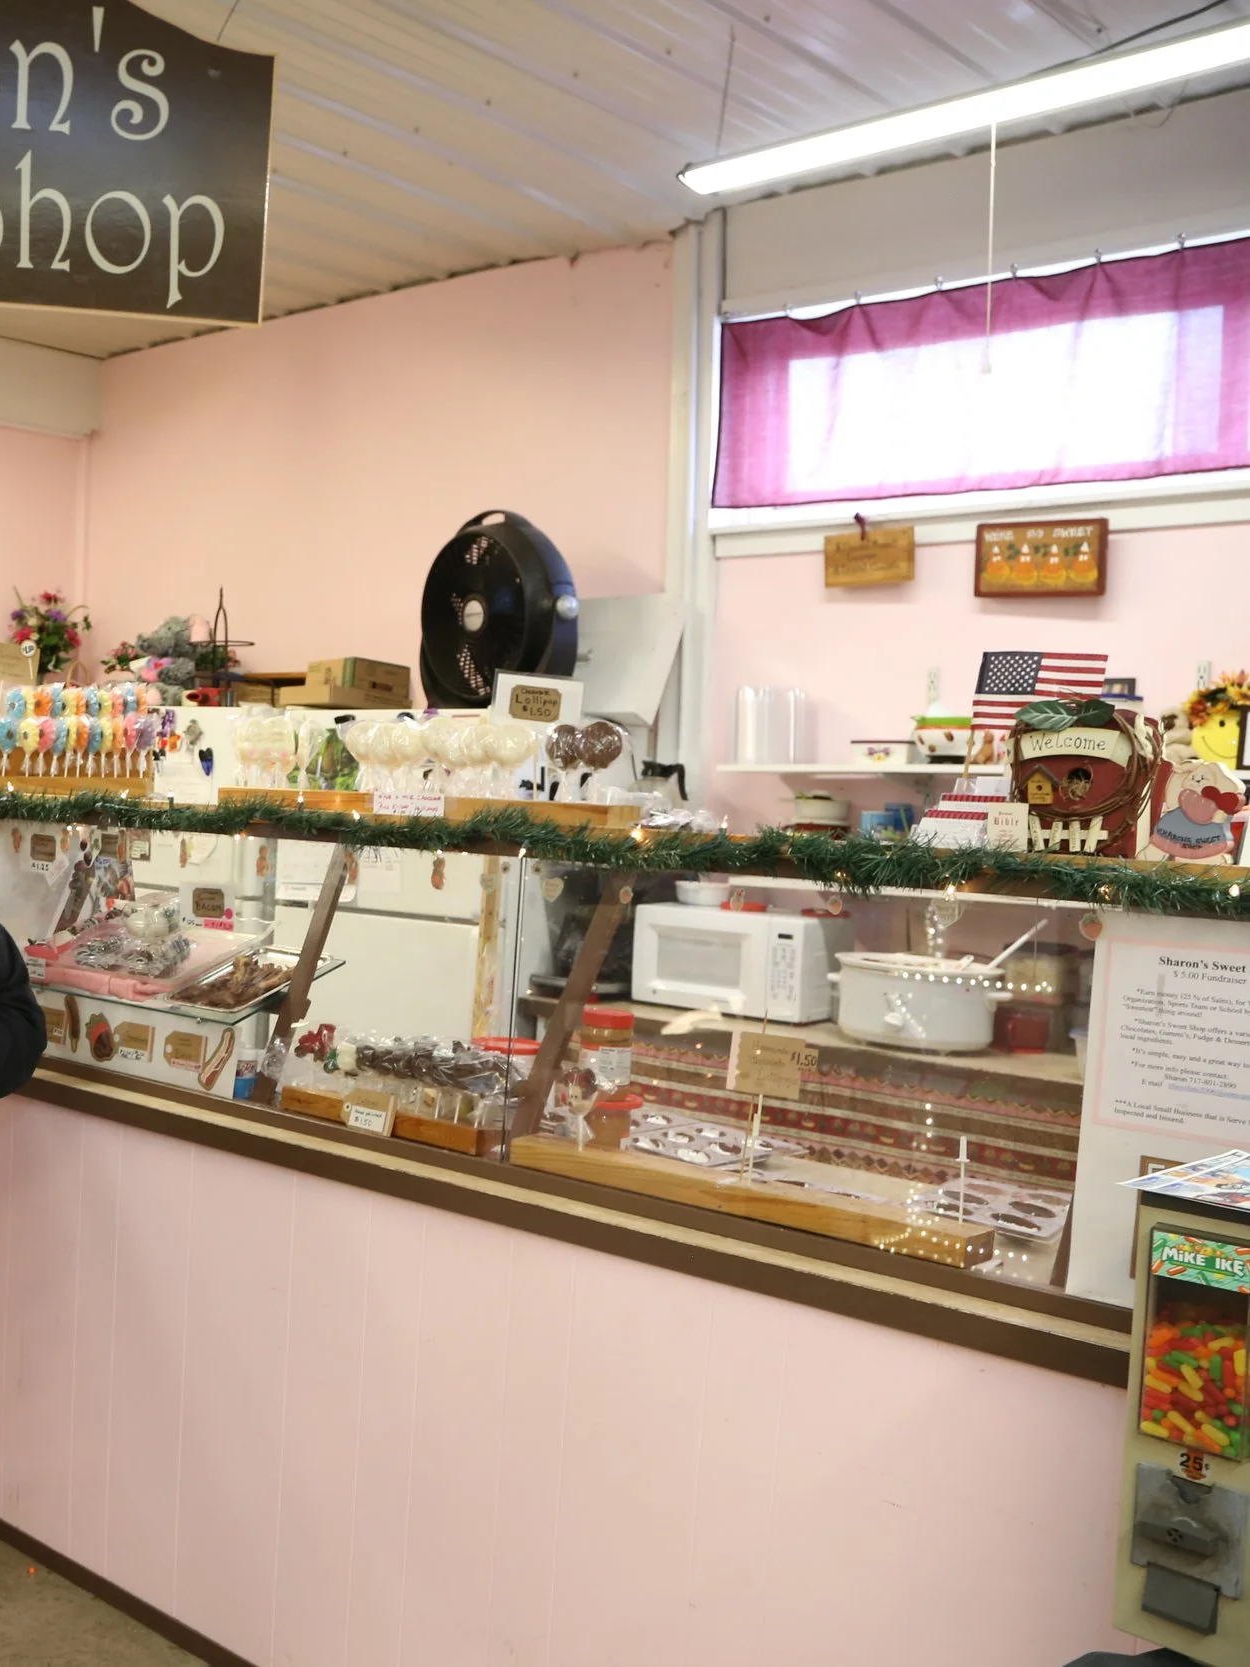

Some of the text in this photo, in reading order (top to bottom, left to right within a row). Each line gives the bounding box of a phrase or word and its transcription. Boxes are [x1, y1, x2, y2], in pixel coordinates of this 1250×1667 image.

[1030, 733, 1106, 751] Welcome
[994, 816, 1019, 826] Bible
[1158, 955, 1246, 973] Sharon's Sweet
[1180, 971, 1200, 980] 5.00
[1201, 972, 1248, 985] Fundraiser
[1168, 999, 1188, 1009] Sports
[1190, 1002, 1208, 1010] Team
[1218, 1006, 1242, 1014] School
[1236, 998, 1246, 1006] for
[1158, 1006, 1176, 1016] thing
[1168, 1021, 1187, 1030] Sweet
[1189, 1024, 1207, 1034] Shop
[1207, 1026, 1228, 1035] offers
[1192, 1033, 1214, 1043] Fudge
[790, 1051, 817, 1067] $1.50
[1148, 1050, 1170, 1059] simple,
[1208, 1058, 1226, 1066] great
[1227, 1060, 1241, 1068] way
[1164, 1073, 1188, 1083] Sharon
[1180, 1068, 1201, 1076] please
[1114, 1107, 1144, 1118] Inspected
[1146, 1112, 1158, 1120] and
[1133, 1102, 1152, 1110] Local
[1153, 1105, 1172, 1114] Small
[1174, 1108, 1203, 1118] Business
[1204, 1112, 1218, 1121] that
[1214, 1257, 1246, 1278] IKE
